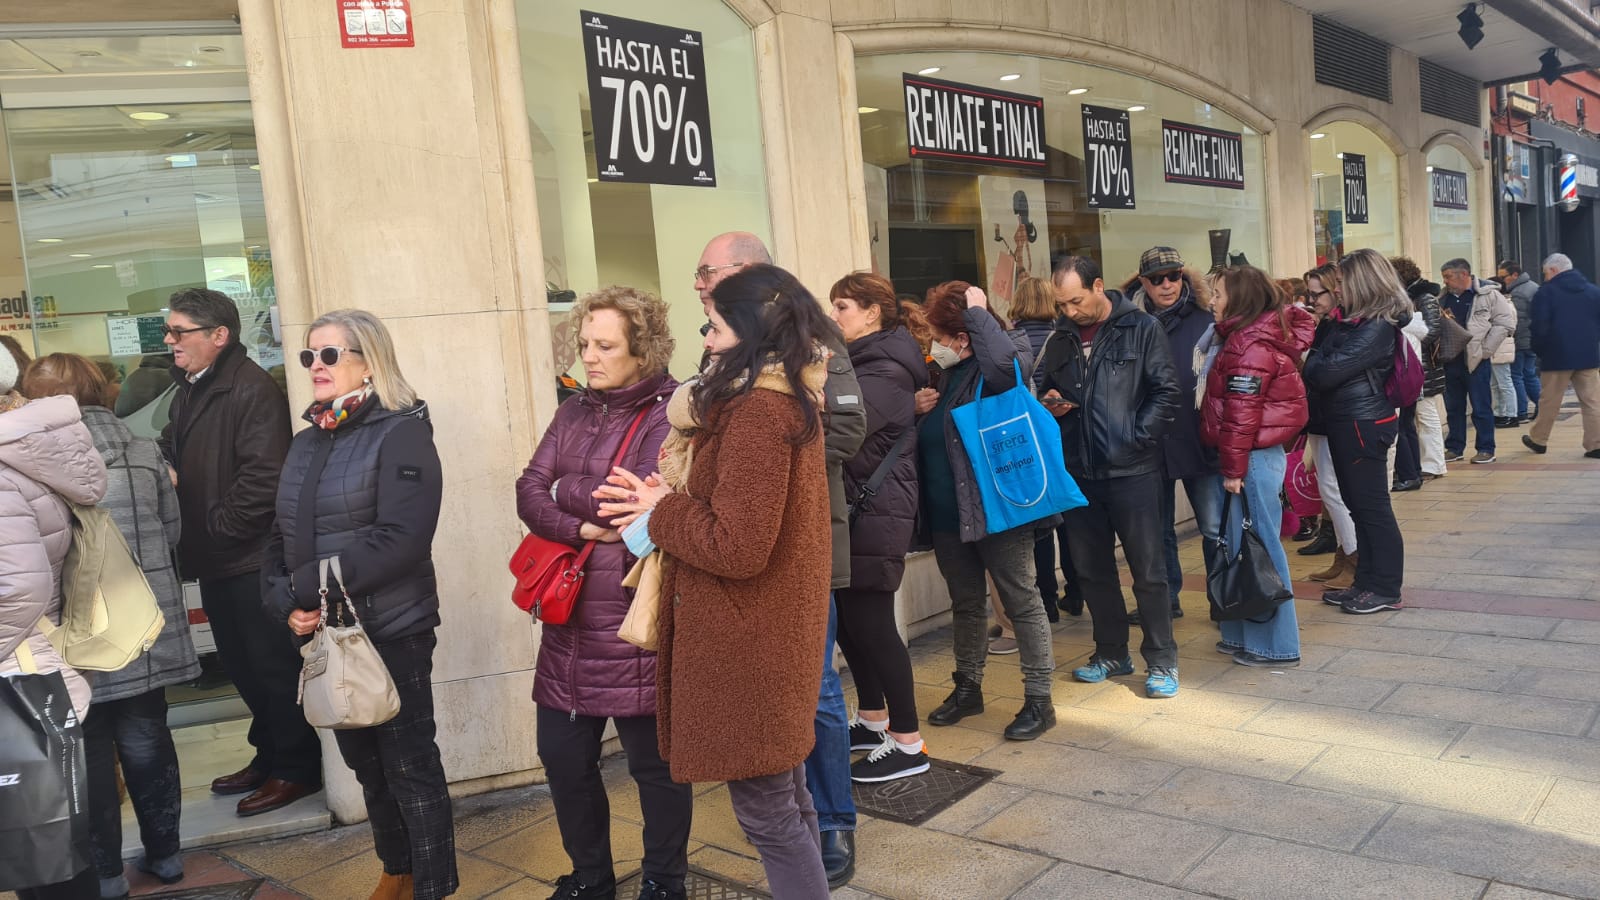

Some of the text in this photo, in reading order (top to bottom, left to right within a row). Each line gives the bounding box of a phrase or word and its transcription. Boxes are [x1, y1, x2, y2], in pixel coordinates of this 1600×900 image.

[596, 35, 696, 80] HASTA EL
[600, 76, 702, 167] 70%
[906, 85, 1046, 161] REMATE FINAL
[1086, 118, 1127, 141] HASTA EL
[1089, 143, 1130, 197] 70%
[1164, 128, 1243, 182] REMATE FINAL
[1344, 161, 1359, 176] HASTA
[1345, 179, 1366, 215] 70%
[1432, 173, 1467, 205] REMATE FINAL
[991, 434, 1028, 453] sirera
[995, 455, 1034, 474] angileptol
